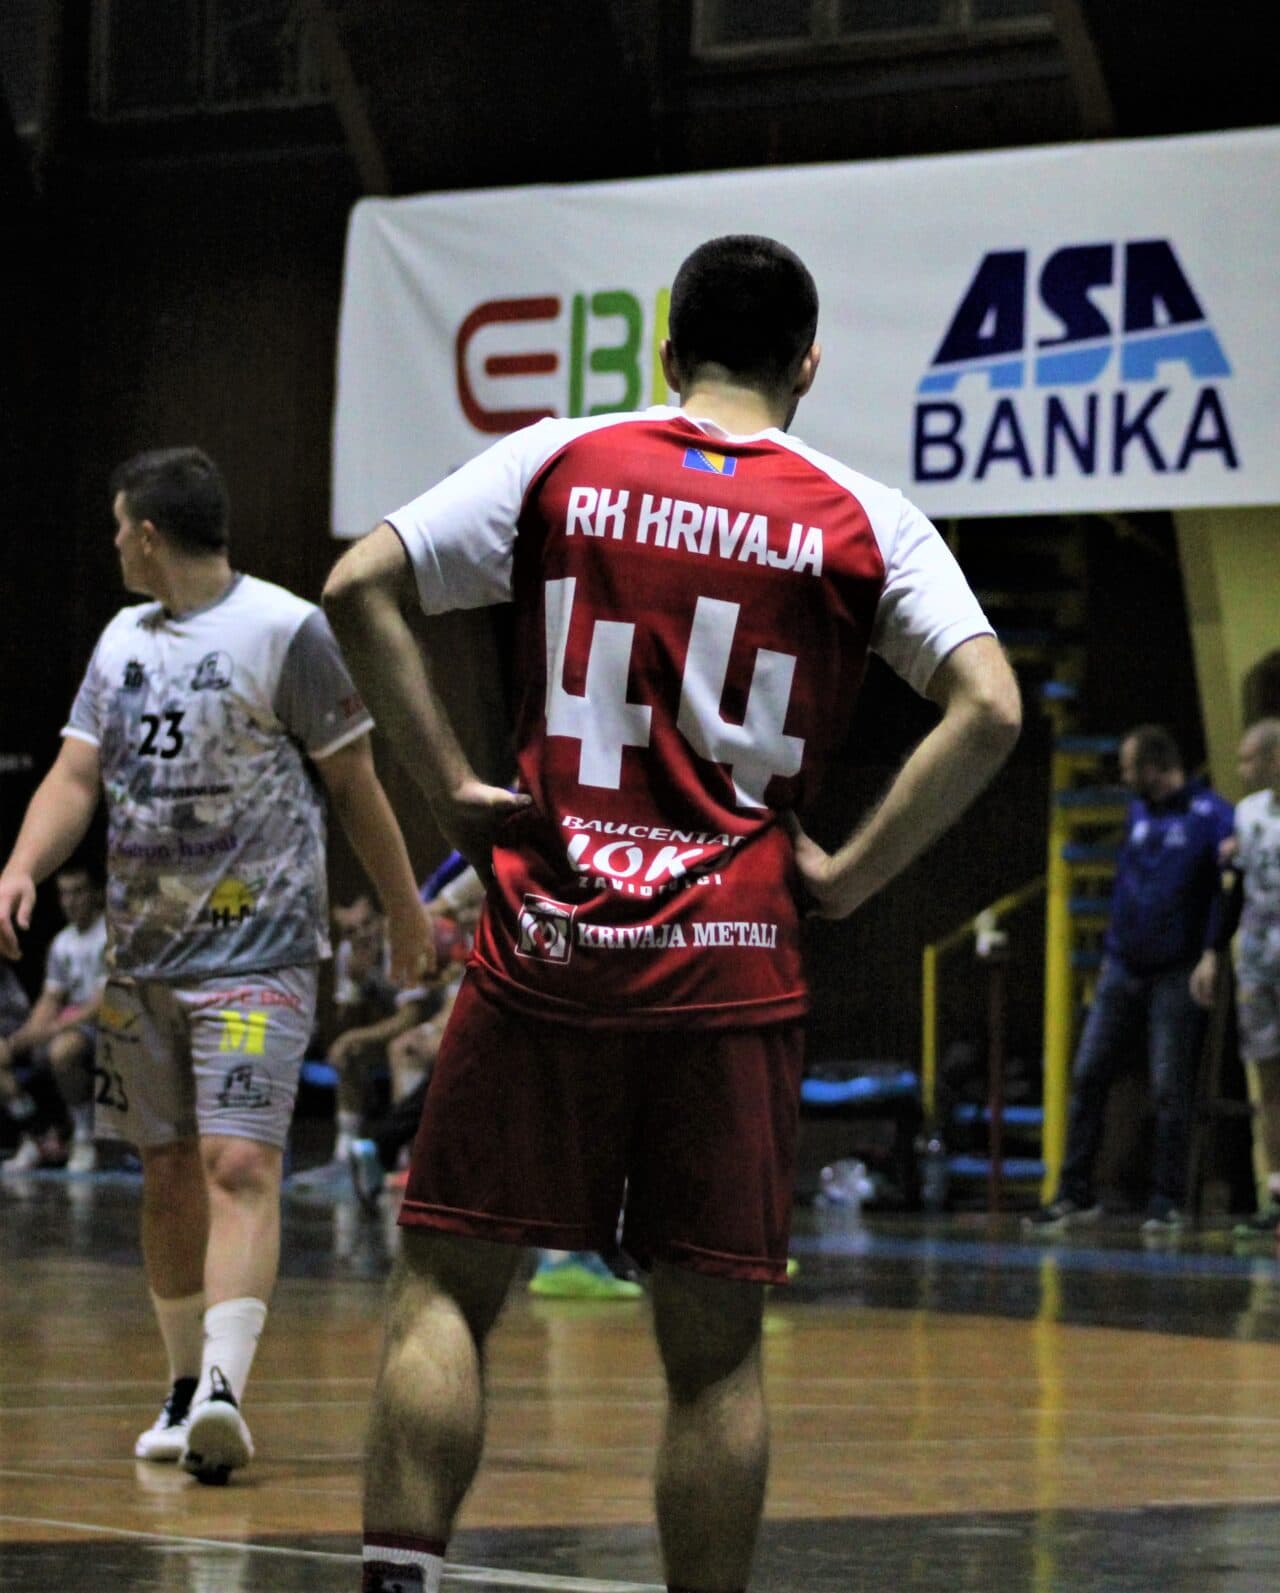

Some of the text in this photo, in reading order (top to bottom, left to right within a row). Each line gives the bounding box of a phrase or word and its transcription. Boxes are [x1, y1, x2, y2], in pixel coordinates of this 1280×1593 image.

[455, 288, 671, 434] EB
[917, 239, 1233, 394] ASA
[914, 386, 1240, 483] BANKA
[566, 486, 824, 577] RK KRIVAJA
[138, 711, 186, 759] 23
[545, 577, 805, 809] 44
[567, 833, 736, 882] LOK
[577, 921, 778, 949] KRIVAJA METALI
